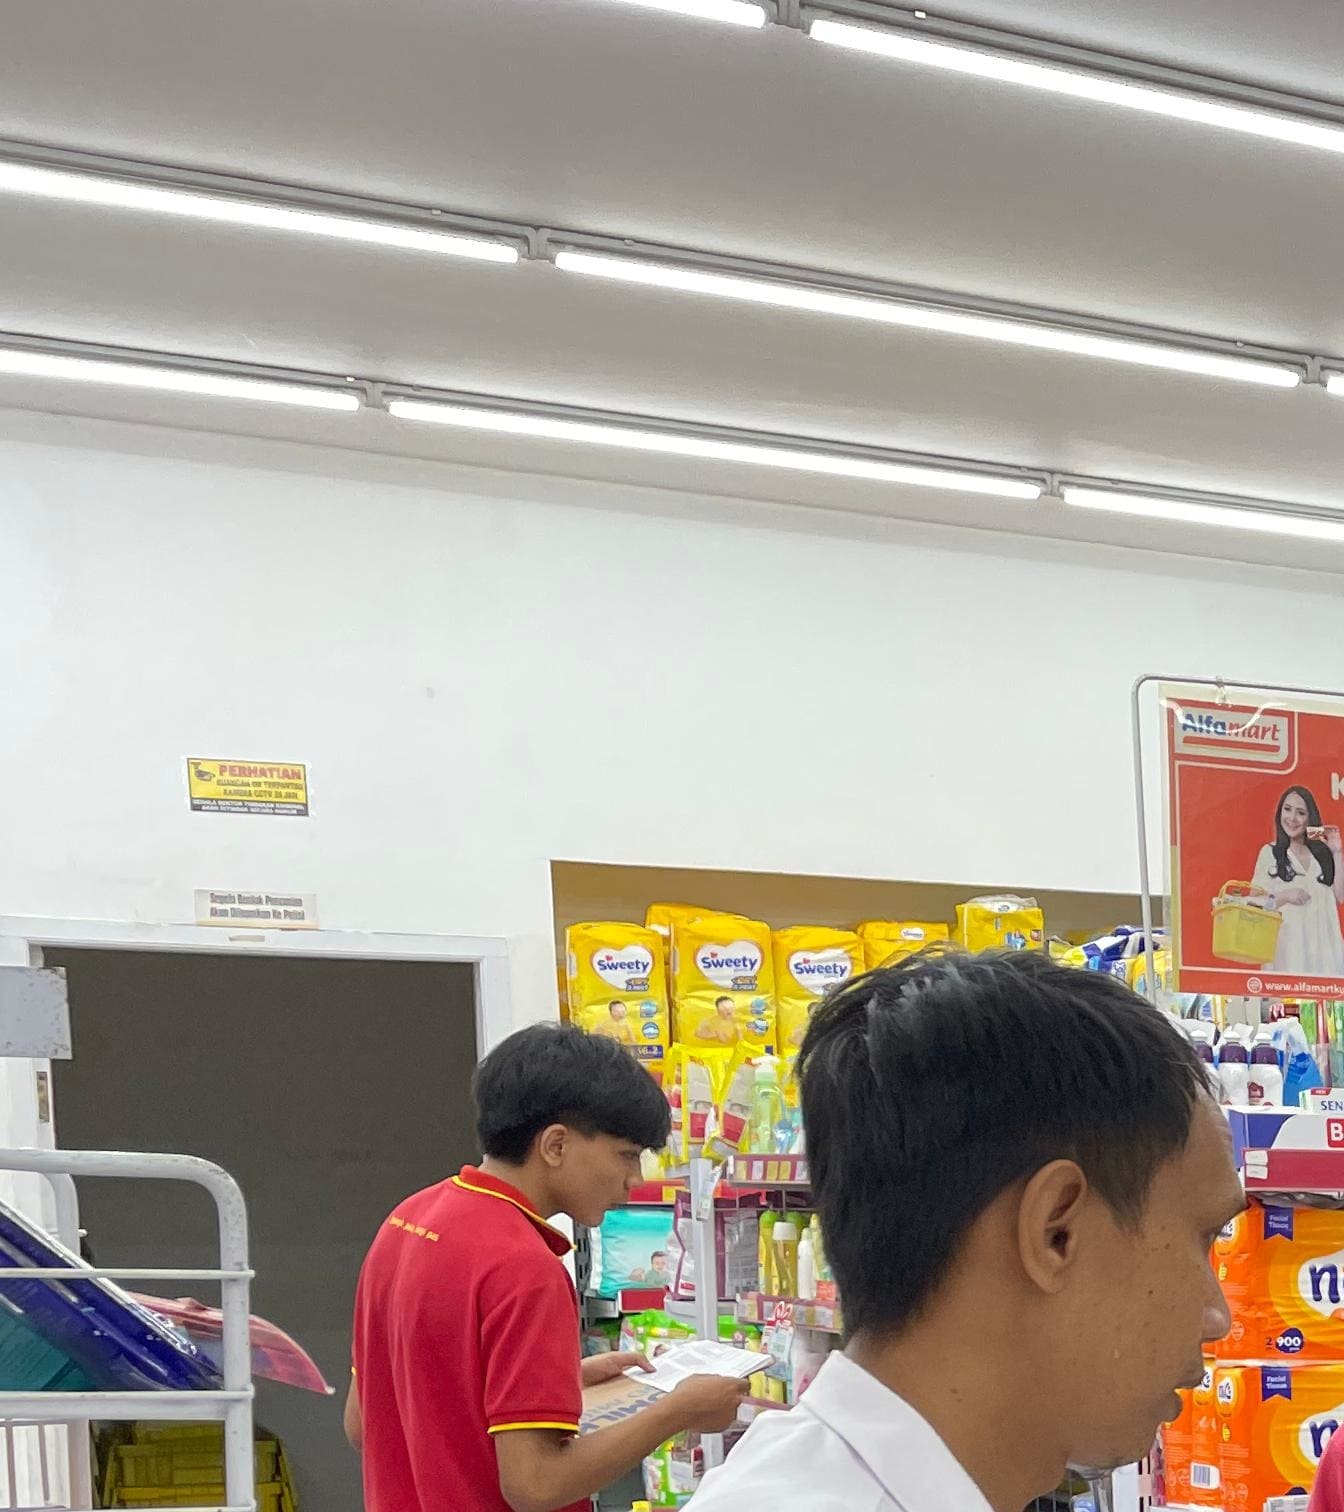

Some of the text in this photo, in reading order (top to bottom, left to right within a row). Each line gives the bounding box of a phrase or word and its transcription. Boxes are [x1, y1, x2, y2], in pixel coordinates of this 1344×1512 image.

[1182, 713, 1280, 741] Alfamart
[597, 958, 650, 973] Sweety
[701, 957, 758, 971] Sweety
[793, 960, 848, 976] Sweety
[1276, 1335, 1302, 1348] 900
